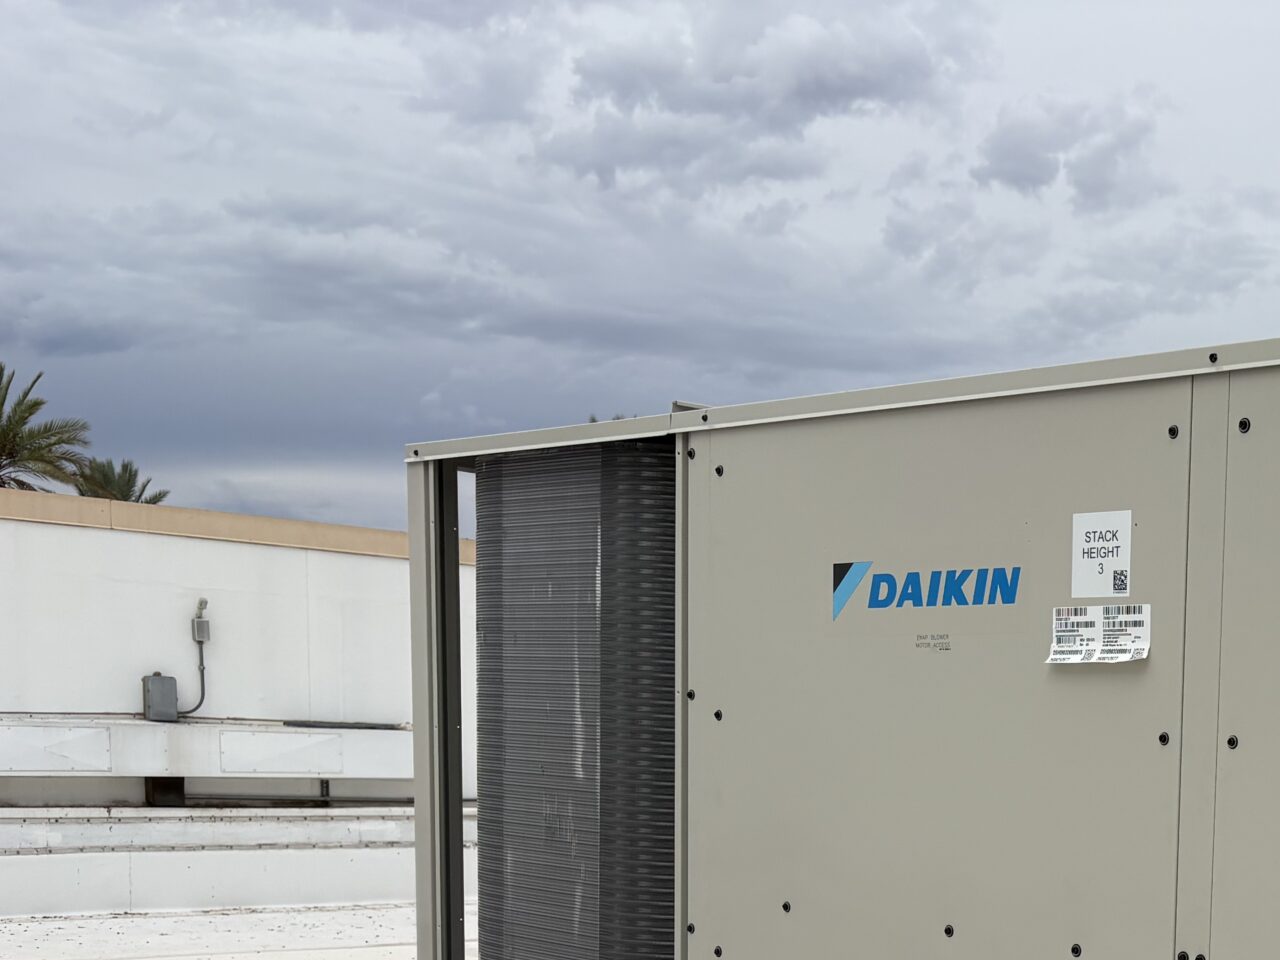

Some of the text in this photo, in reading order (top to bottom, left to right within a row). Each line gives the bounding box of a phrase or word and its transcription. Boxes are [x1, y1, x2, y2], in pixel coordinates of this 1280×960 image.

[1084, 530, 1119, 543] STACK
[1082, 546, 1121, 559] HEIGHT
[1098, 562, 1104, 574] 3
[868, 566, 1021, 608] DAIKIN
